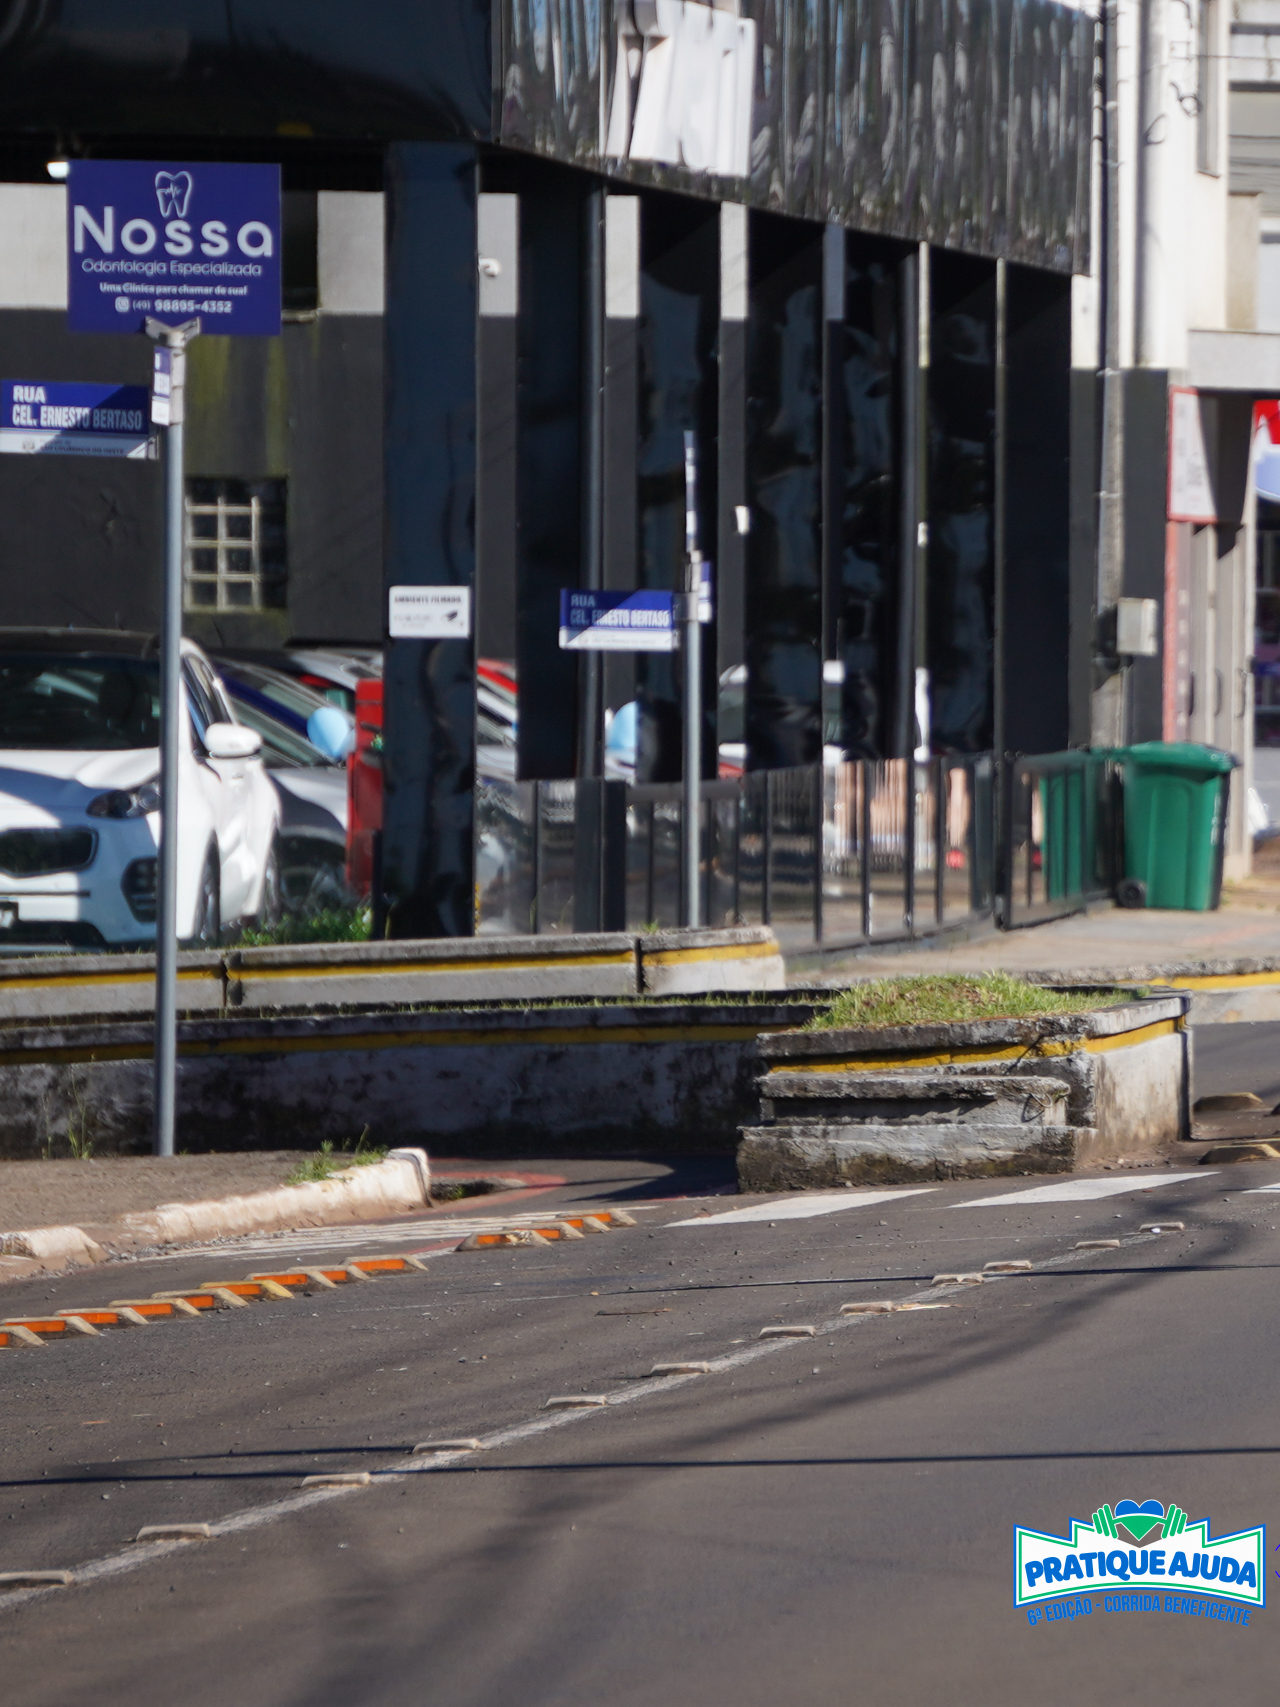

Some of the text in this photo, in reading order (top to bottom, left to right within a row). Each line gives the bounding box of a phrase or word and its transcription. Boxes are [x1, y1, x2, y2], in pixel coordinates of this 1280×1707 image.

[73, 204, 273, 257] Nossa
[82, 258, 262, 277] Odontologia Especializada
[99, 282, 121, 293] Uma
[156, 284, 178, 296] para
[132, 300, 151, 312] (49)
[13, 385, 46, 403] RUA
[12, 404, 143, 430] CEL. ERNESTO BERTASO
[571, 594, 596, 607] RUA
[591, 609, 630, 627] ERNESTO
[630, 609, 671, 628] BERTASO
